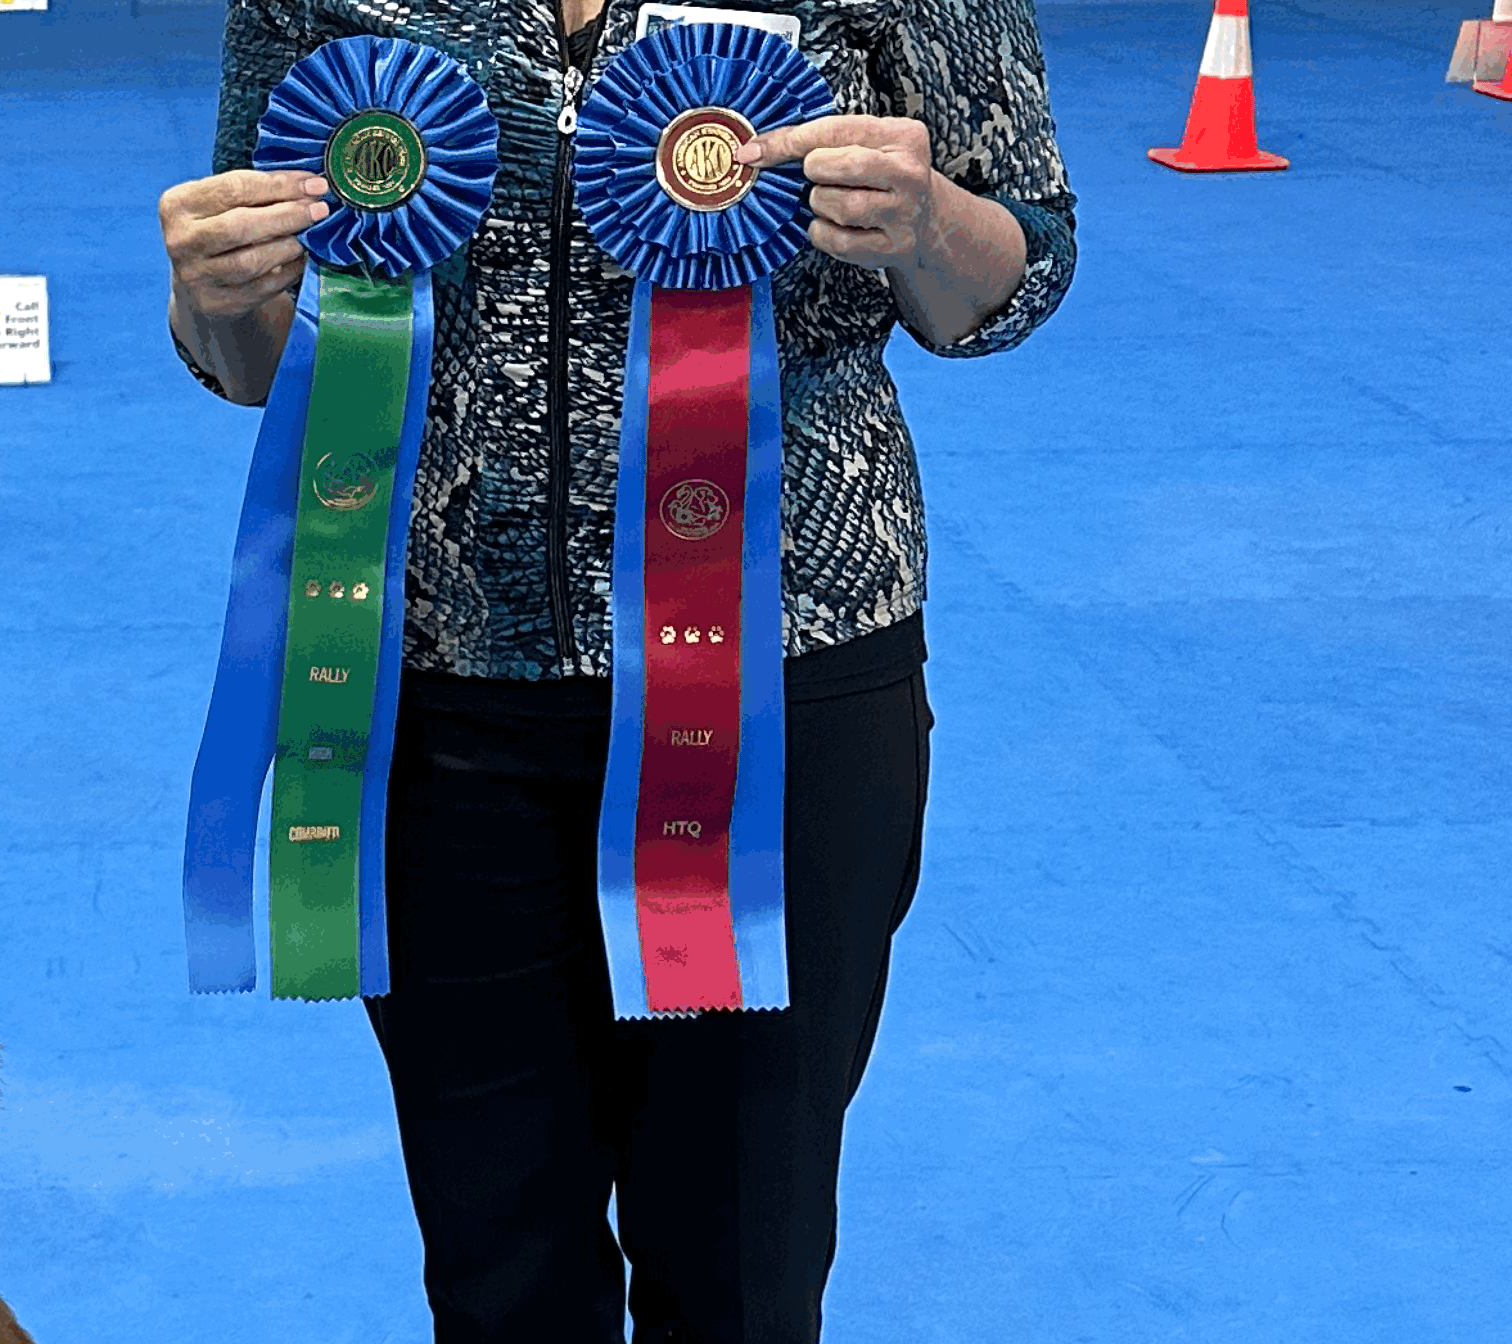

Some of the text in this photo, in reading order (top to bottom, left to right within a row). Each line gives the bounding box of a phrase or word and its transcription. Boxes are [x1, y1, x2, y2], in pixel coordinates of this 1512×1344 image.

[356, 139, 395, 180] AKC
[690, 140, 726, 179] AKC
[5, 315, 39, 324] Front
[5, 327, 39, 338] Right
[308, 666, 350, 683] RALLY
[671, 730, 714, 746] RALLY
[662, 820, 702, 839] HTQ
